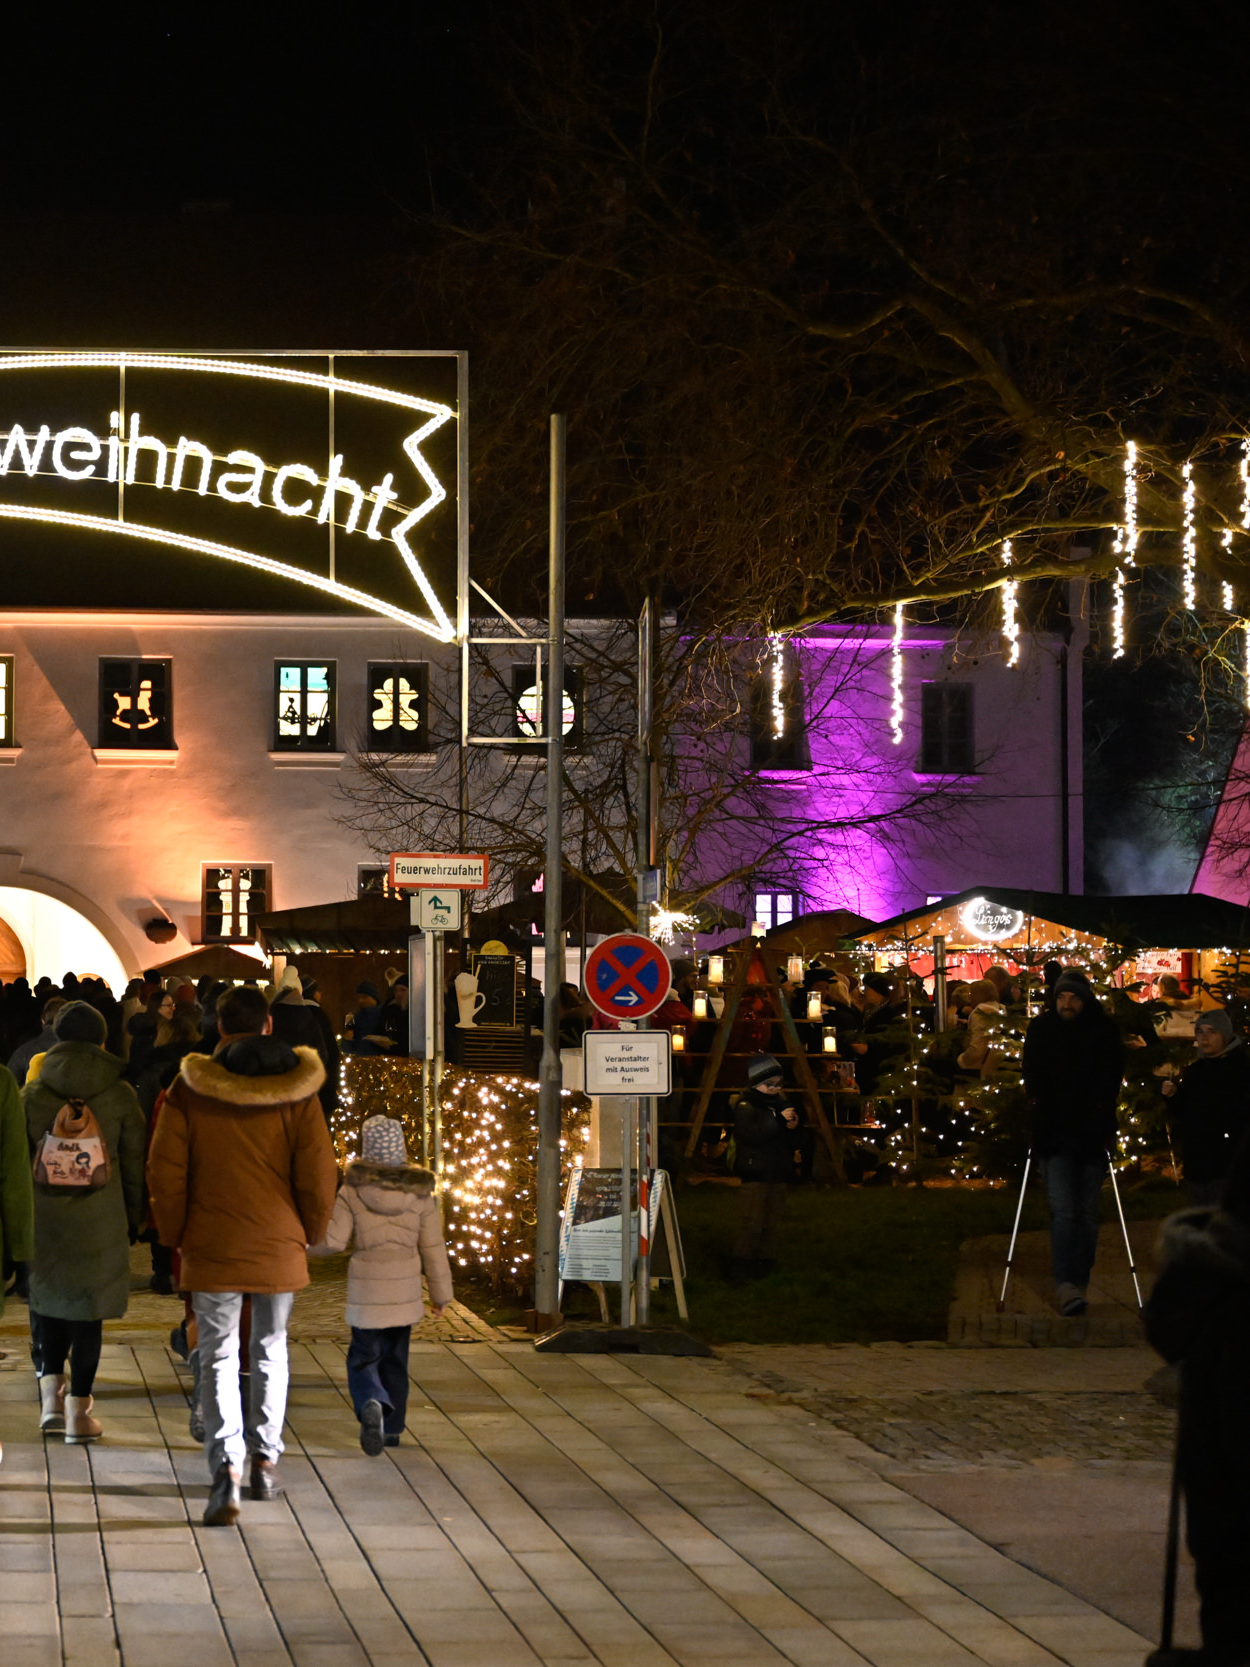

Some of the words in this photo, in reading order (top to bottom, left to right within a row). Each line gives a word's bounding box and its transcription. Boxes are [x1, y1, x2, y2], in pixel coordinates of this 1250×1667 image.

[395, 862, 483, 877] Feuerwehrzufahrt
[621, 1044, 634, 1052] Für
[604, 1054, 650, 1063] Veranstalter
